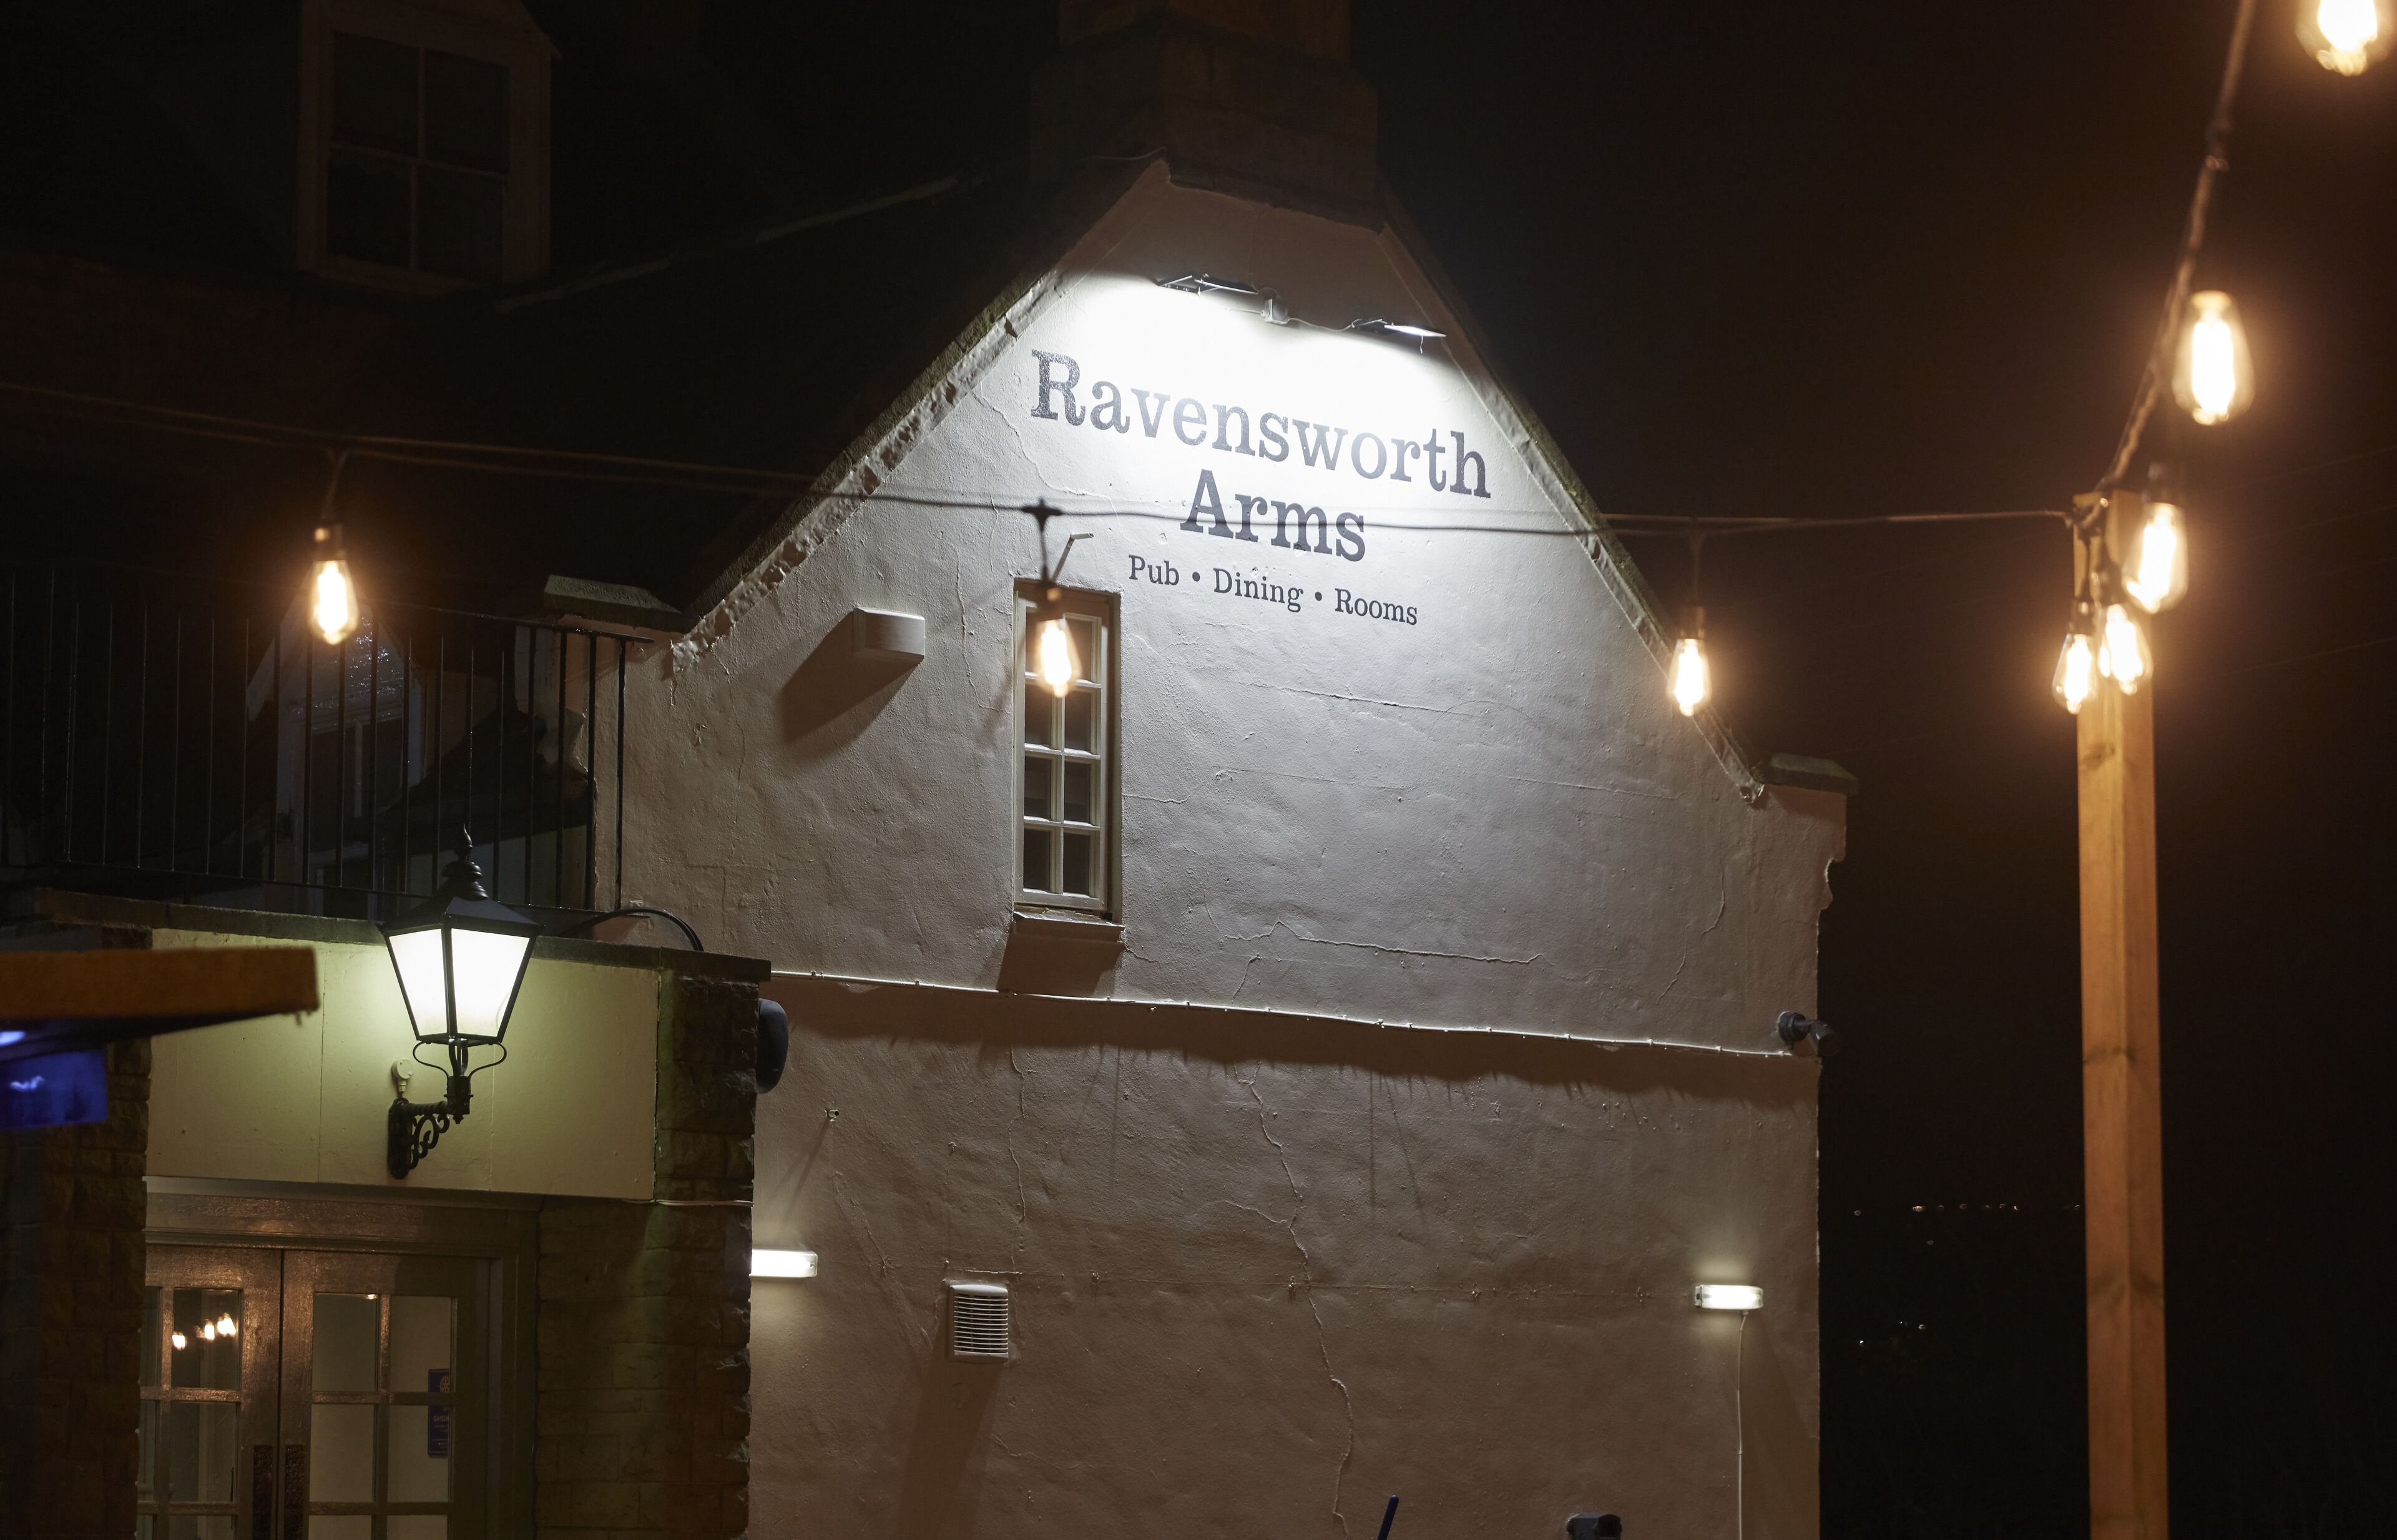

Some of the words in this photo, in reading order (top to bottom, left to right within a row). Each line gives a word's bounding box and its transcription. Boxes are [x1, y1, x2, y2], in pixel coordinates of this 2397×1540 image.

[1031, 350, 1491, 498] Ravensworth
[1180, 469, 1366, 561] Arms
[1129, 555, 1180, 586] Pub
[1213, 568, 1303, 612] Dining
[1335, 588, 1418, 625] Rooms
